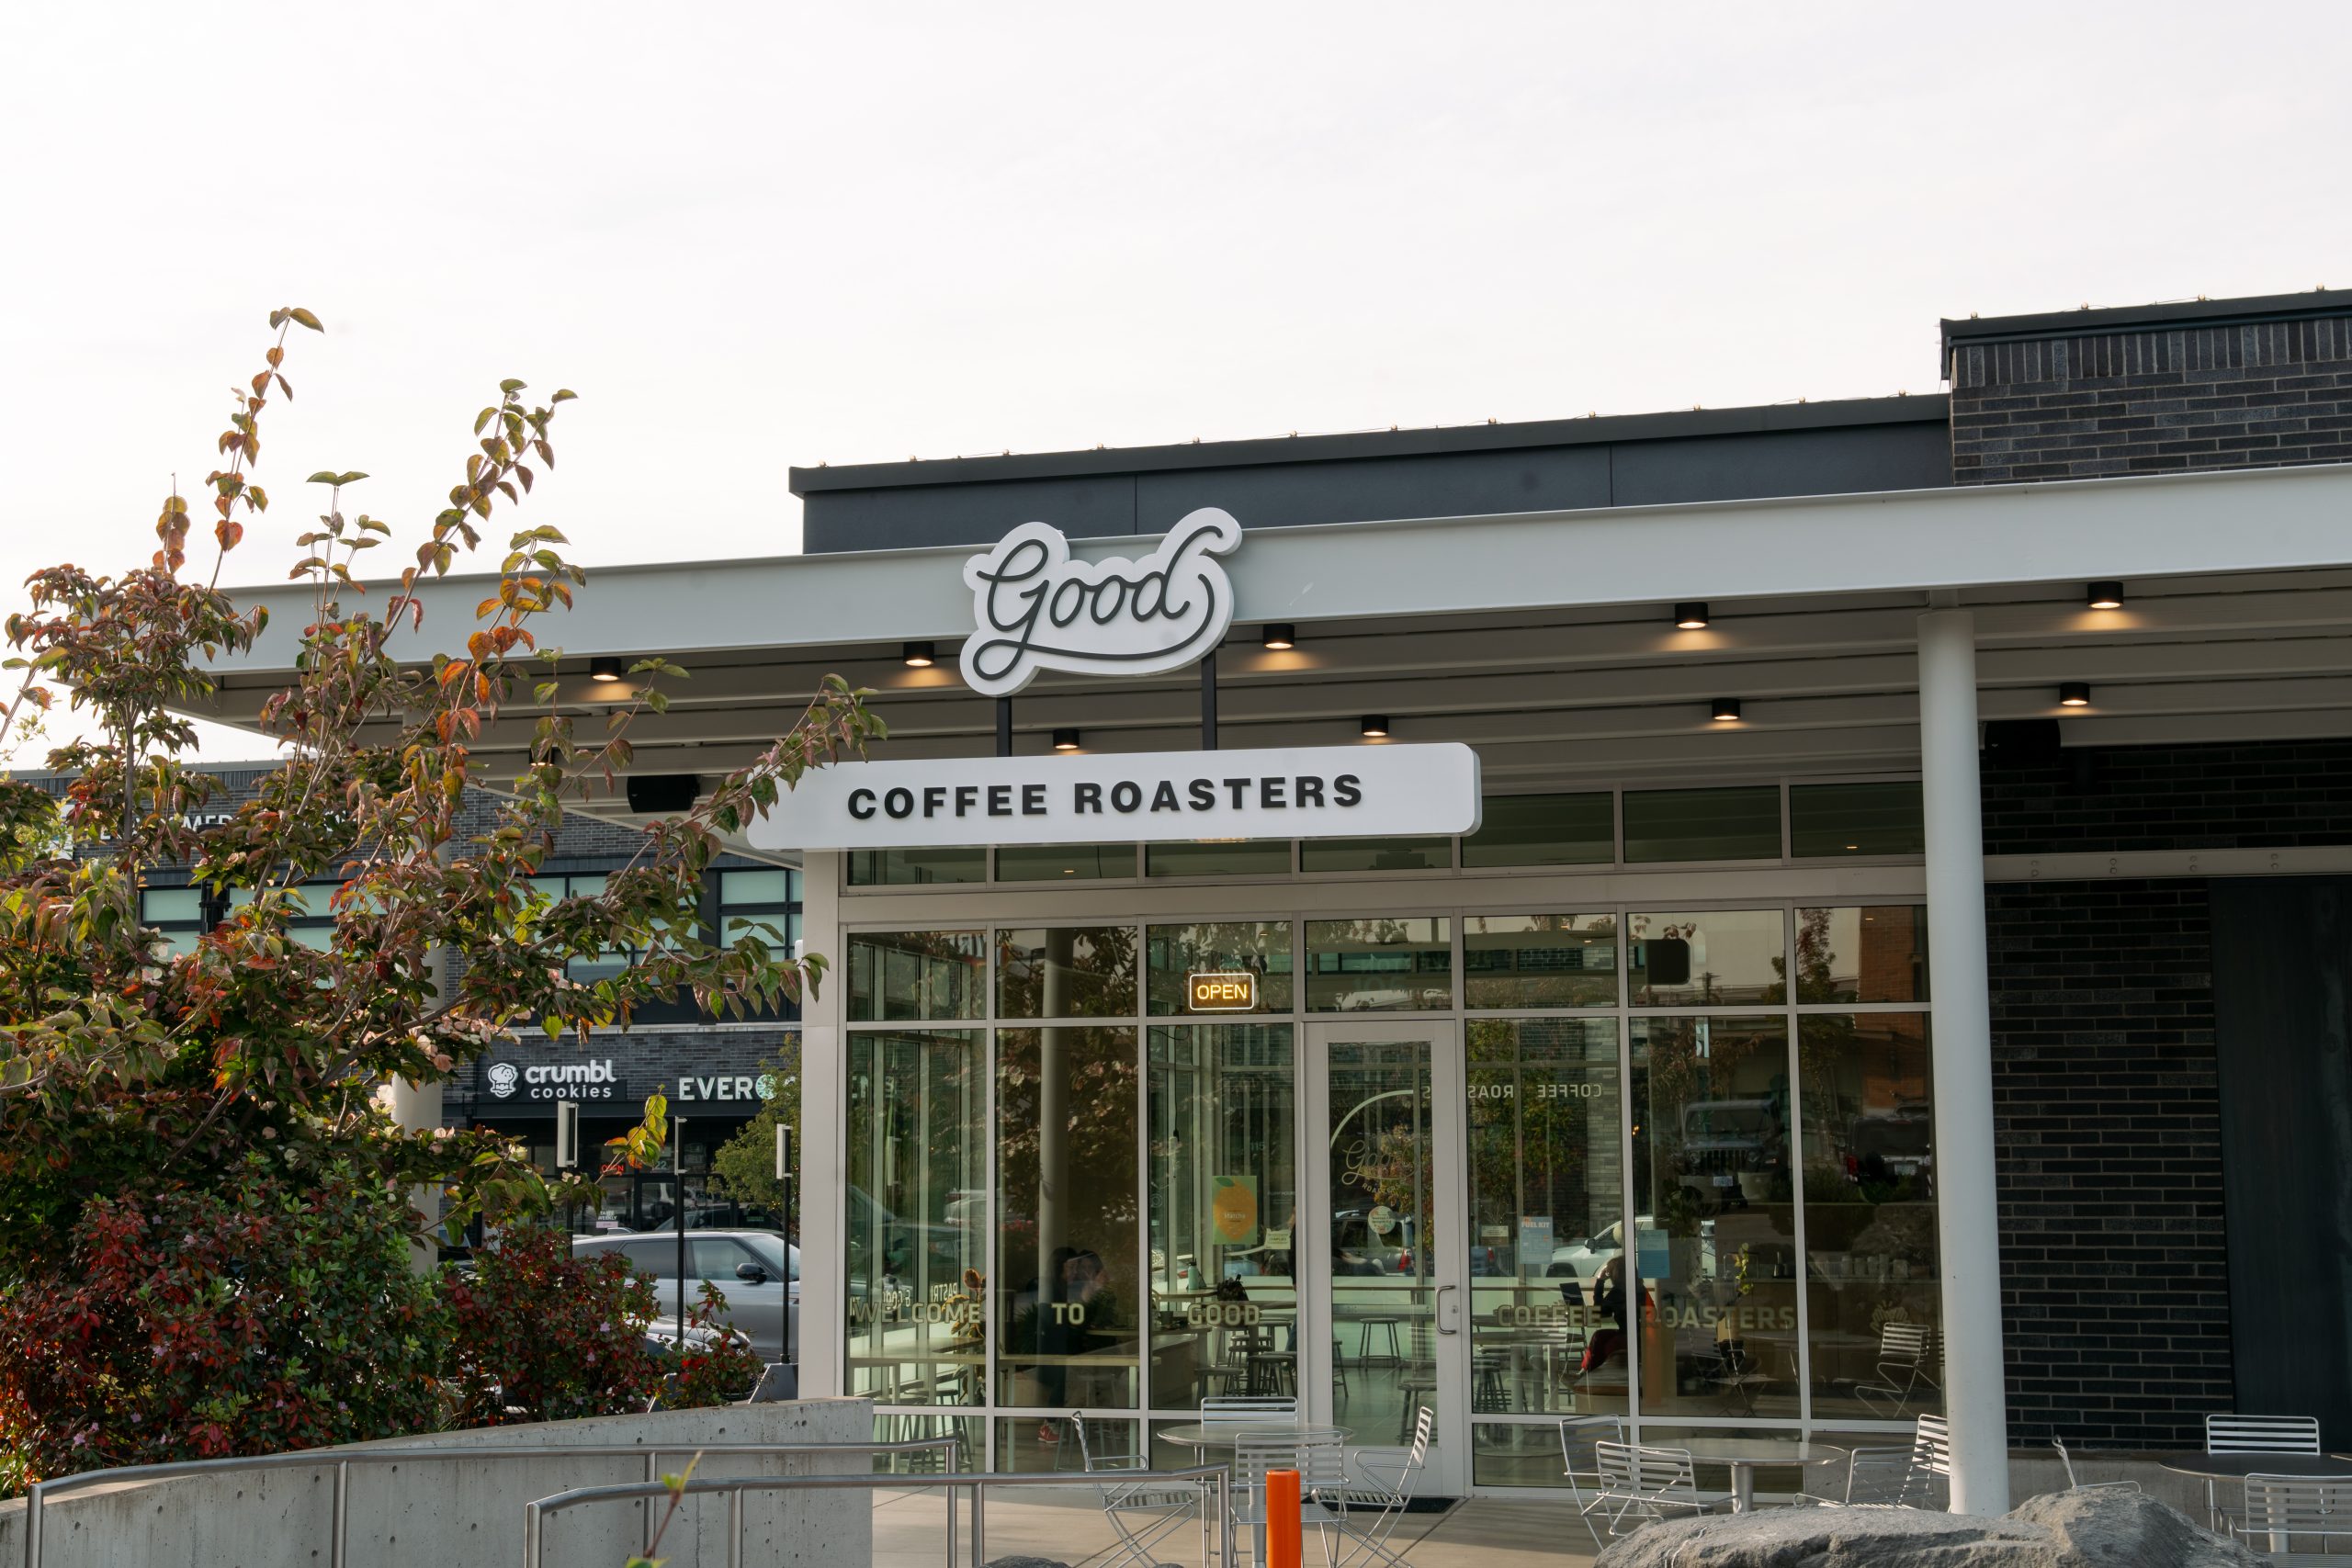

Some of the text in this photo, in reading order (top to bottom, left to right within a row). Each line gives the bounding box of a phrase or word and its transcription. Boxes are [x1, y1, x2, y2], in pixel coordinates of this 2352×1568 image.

[971, 525, 1225, 682] Good
[847, 772, 1364, 820] COFFEE ROASTERS
[1196, 983, 1249, 1001] OPEN
[526, 1059, 617, 1084] crumbl
[530, 1083, 613, 1099] cookies
[602, 1165, 624, 1173] ON
[854, 1302, 981, 1324] WELCOME
[1051, 1302, 1086, 1325] TO
[1187, 1302, 1261, 1326] GOOD
[1496, 1303, 1602, 1328] COFFEE
[1640, 1305, 1796, 1330] ROASTERS
